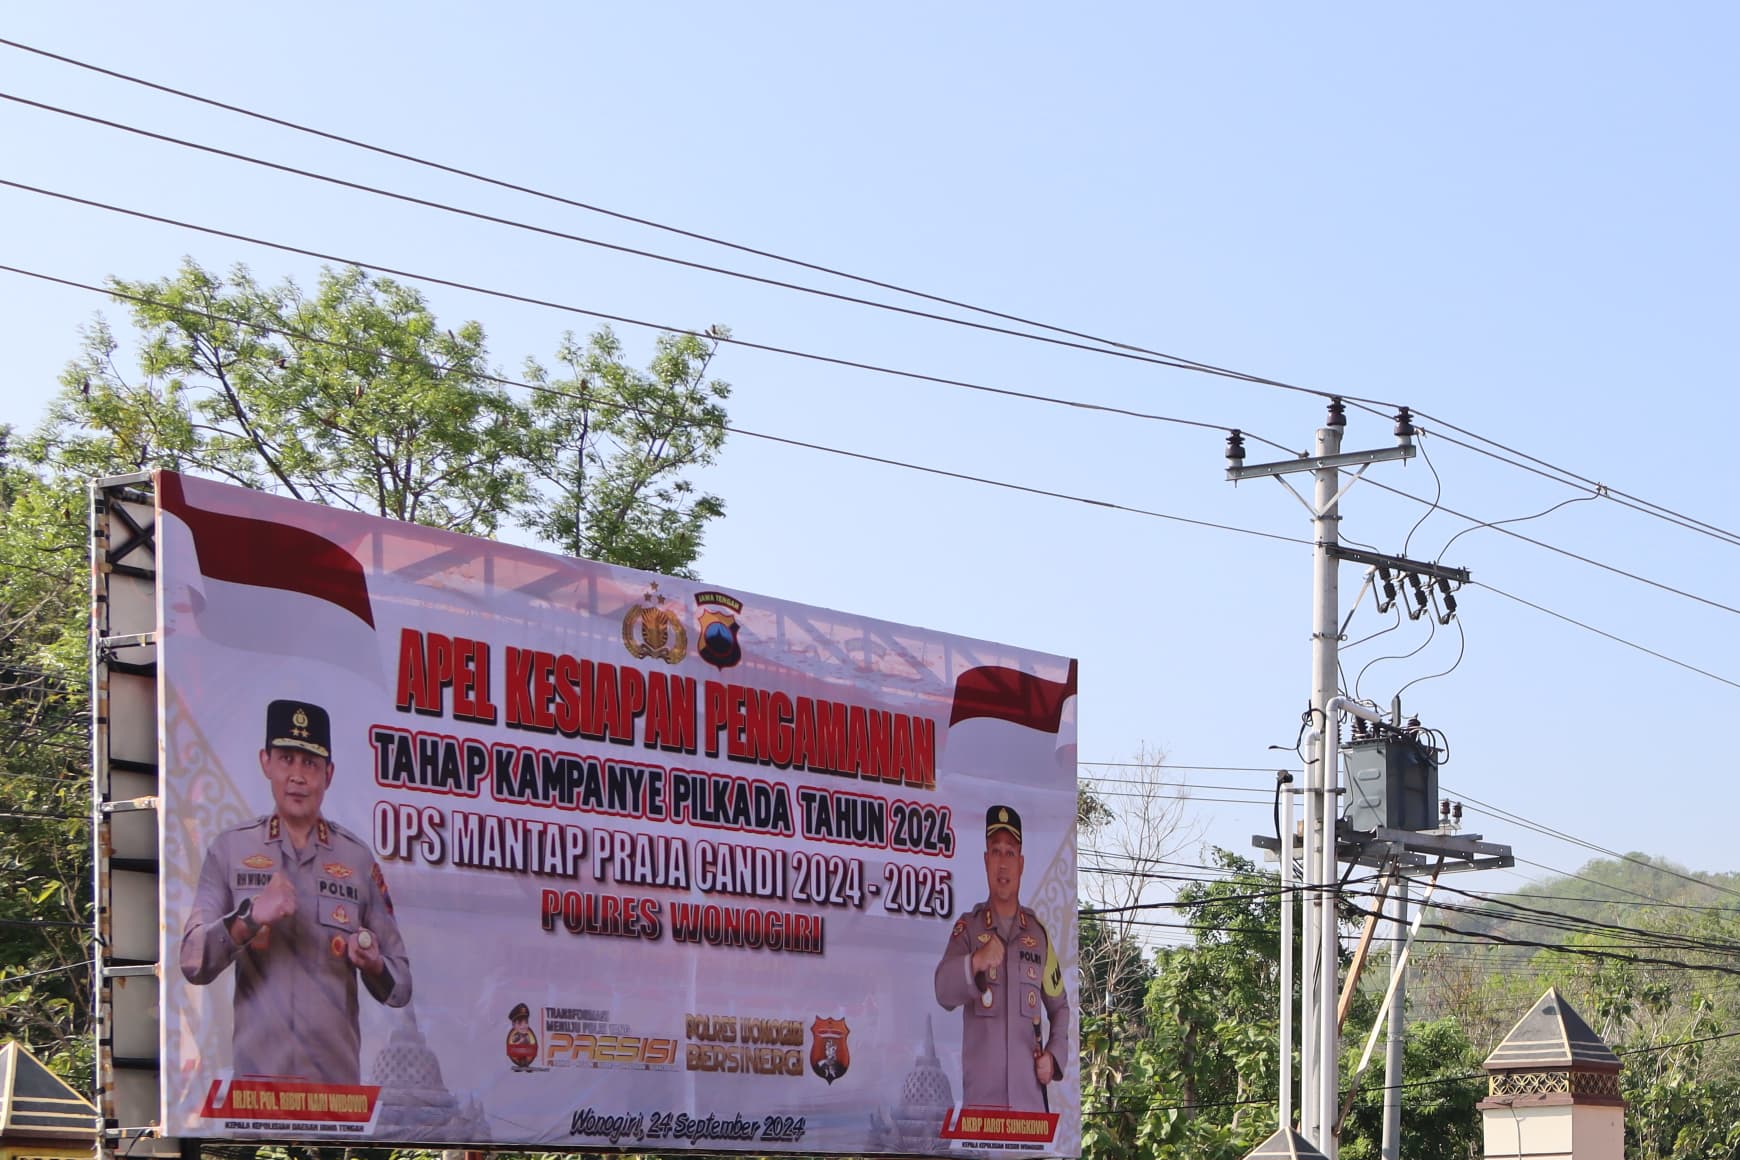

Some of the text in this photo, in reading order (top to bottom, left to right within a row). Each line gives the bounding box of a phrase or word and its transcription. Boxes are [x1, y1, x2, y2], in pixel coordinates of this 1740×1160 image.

[396, 627, 936, 791] APEL KESIAPAN PENGAMANAN
[373, 730, 952, 853] TAHAP KAMPANYE PILKADA TAHUN 2024
[319, 880, 358, 900] POLRI
[373, 801, 952, 918] OPS MANTAP PRAJA CANDI 2024 - 2025
[541, 889, 824, 954] POLRES WONOGIRI
[547, 1033, 678, 1064] PRESISI
[570, 1108, 805, 1145] Wonogiri, 24 September 2024
